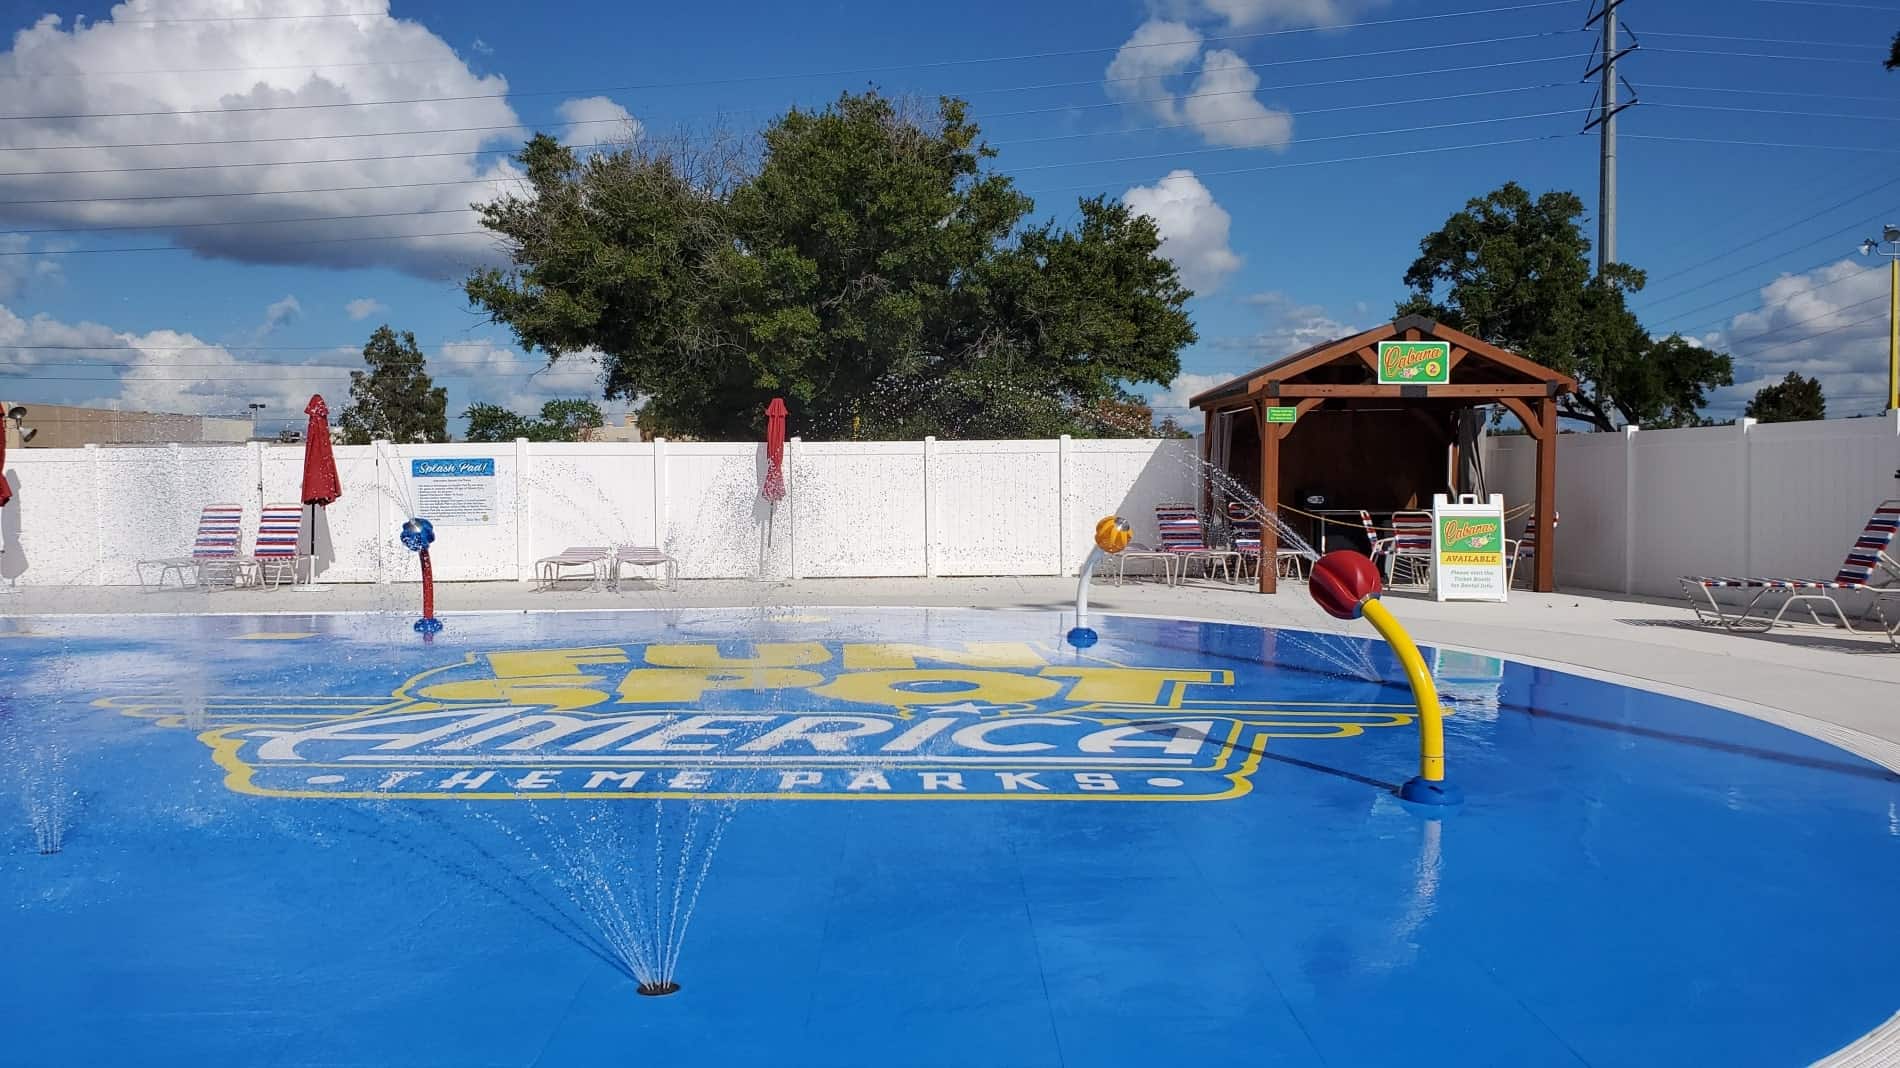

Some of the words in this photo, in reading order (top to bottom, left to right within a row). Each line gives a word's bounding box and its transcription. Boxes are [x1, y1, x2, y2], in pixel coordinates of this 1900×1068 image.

[1384, 346, 1443, 377] Cabana
[1429, 363, 1436, 374] 2
[419, 462, 456, 474] Splash
[459, 462, 488, 473] Pad!
[1445, 520, 1496, 546] Cabanas
[1445, 555, 1497, 563] AVAILABLE
[417, 666, 1212, 711] SPOT
[243, 706, 1214, 760] AMERICA
[378, 770, 712, 790] THEME
[779, 771, 1120, 791] PARKS
